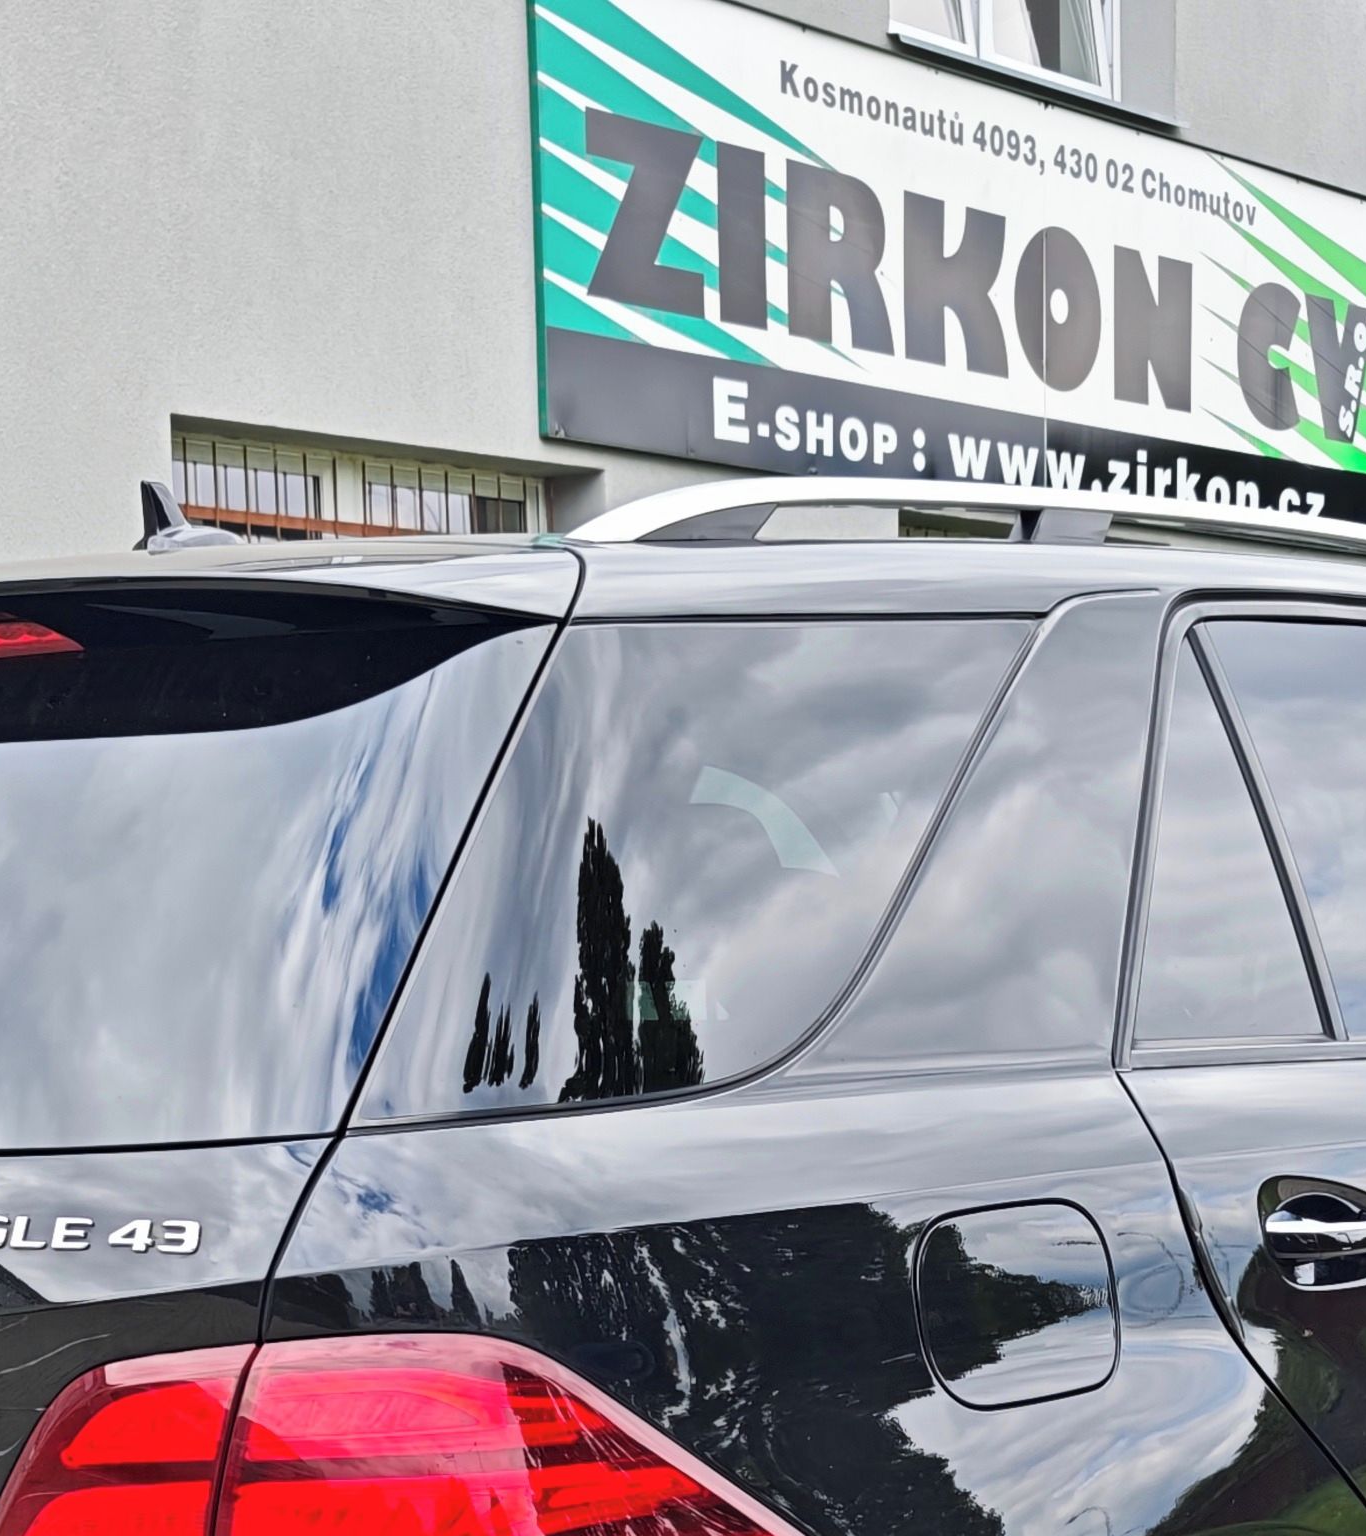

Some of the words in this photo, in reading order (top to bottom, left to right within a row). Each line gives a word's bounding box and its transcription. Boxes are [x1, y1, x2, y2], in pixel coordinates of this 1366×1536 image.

[779, 59, 964, 146] Kosmonautů
[972, 121, 1046, 176] 4093,
[1053, 144, 1097, 183] 430
[1105, 156, 1134, 193] 02
[1141, 166, 1257, 227] Chomutov
[585, 106, 1192, 413] ZIRKON
[107, 1218, 202, 1254] 43
